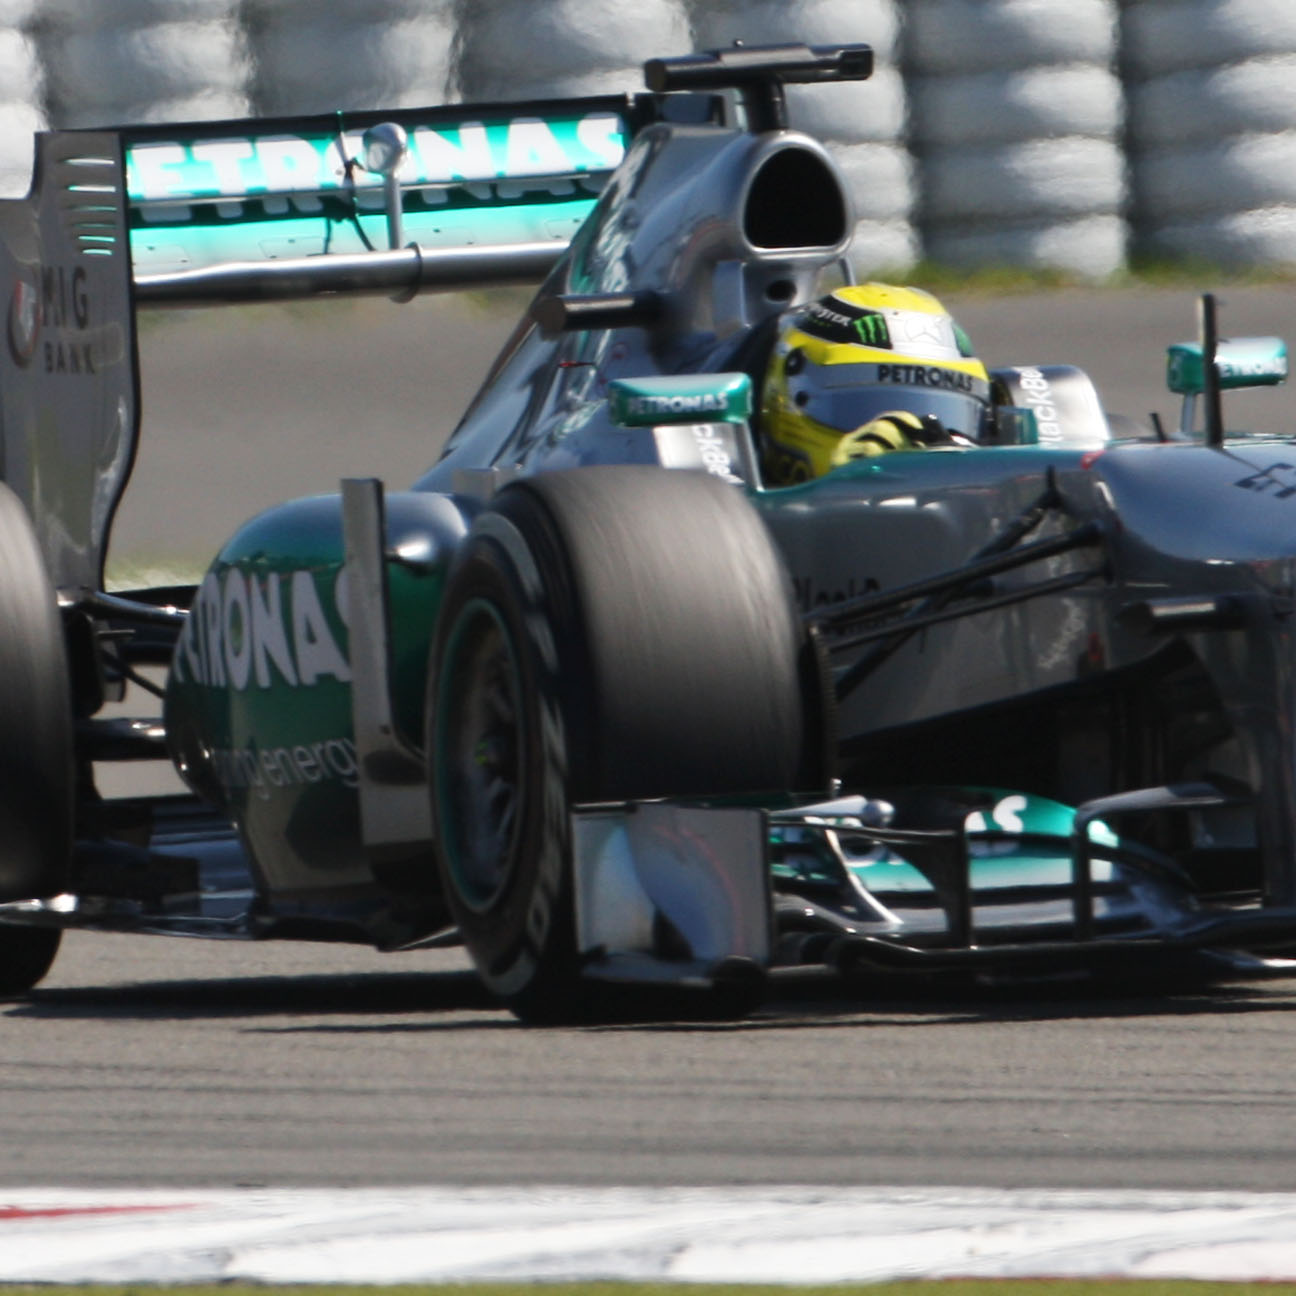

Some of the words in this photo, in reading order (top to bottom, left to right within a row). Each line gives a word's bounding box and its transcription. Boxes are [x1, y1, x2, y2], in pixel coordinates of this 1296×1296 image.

[126, 112, 624, 201] ETRONAS
[877, 364, 973, 392] PETRONAS
[627, 391, 728, 415] PETRONAS
